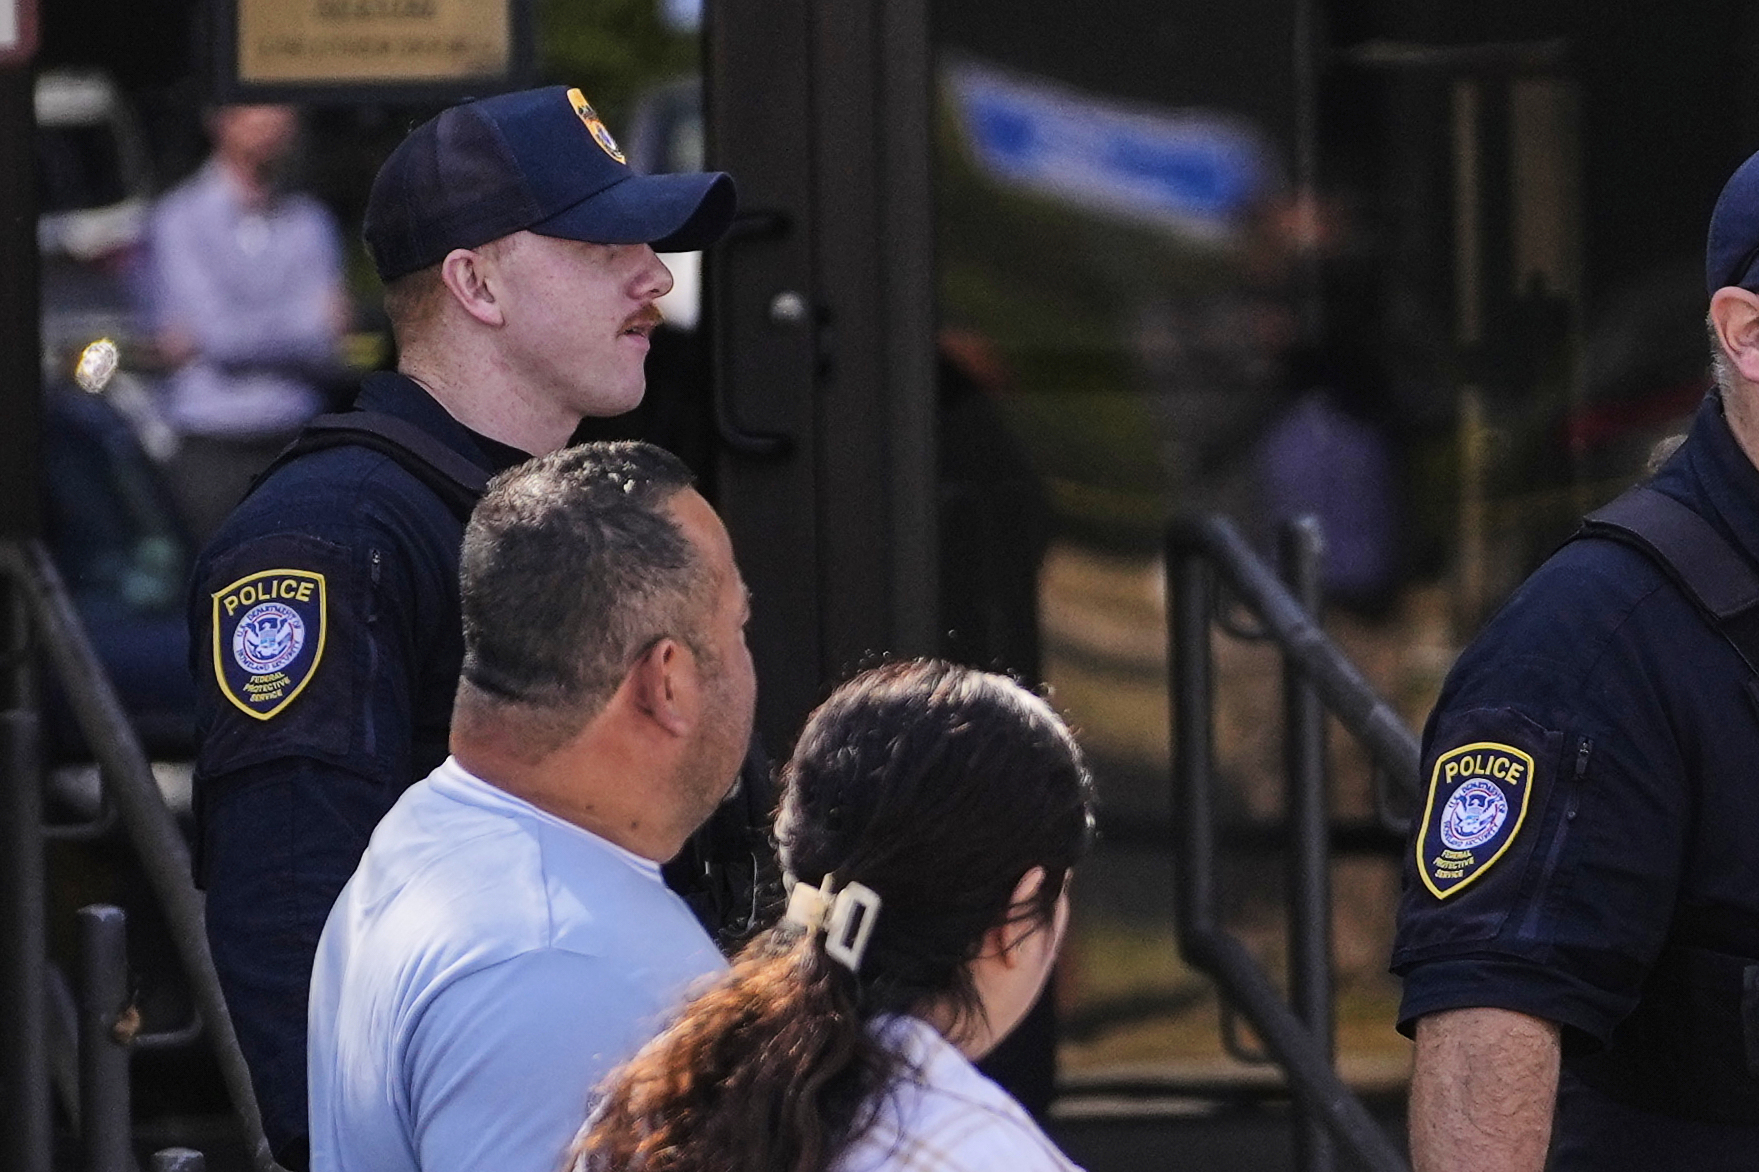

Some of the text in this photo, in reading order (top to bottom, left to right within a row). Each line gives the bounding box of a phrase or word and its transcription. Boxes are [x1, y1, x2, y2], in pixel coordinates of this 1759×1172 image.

[223, 579, 315, 616] POLICE
[242, 676, 291, 693] PROTECTIVE
[250, 671, 286, 684] FEDERAL
[249, 688, 283, 702] SERVICE
[1445, 755, 1525, 785] POLICE
